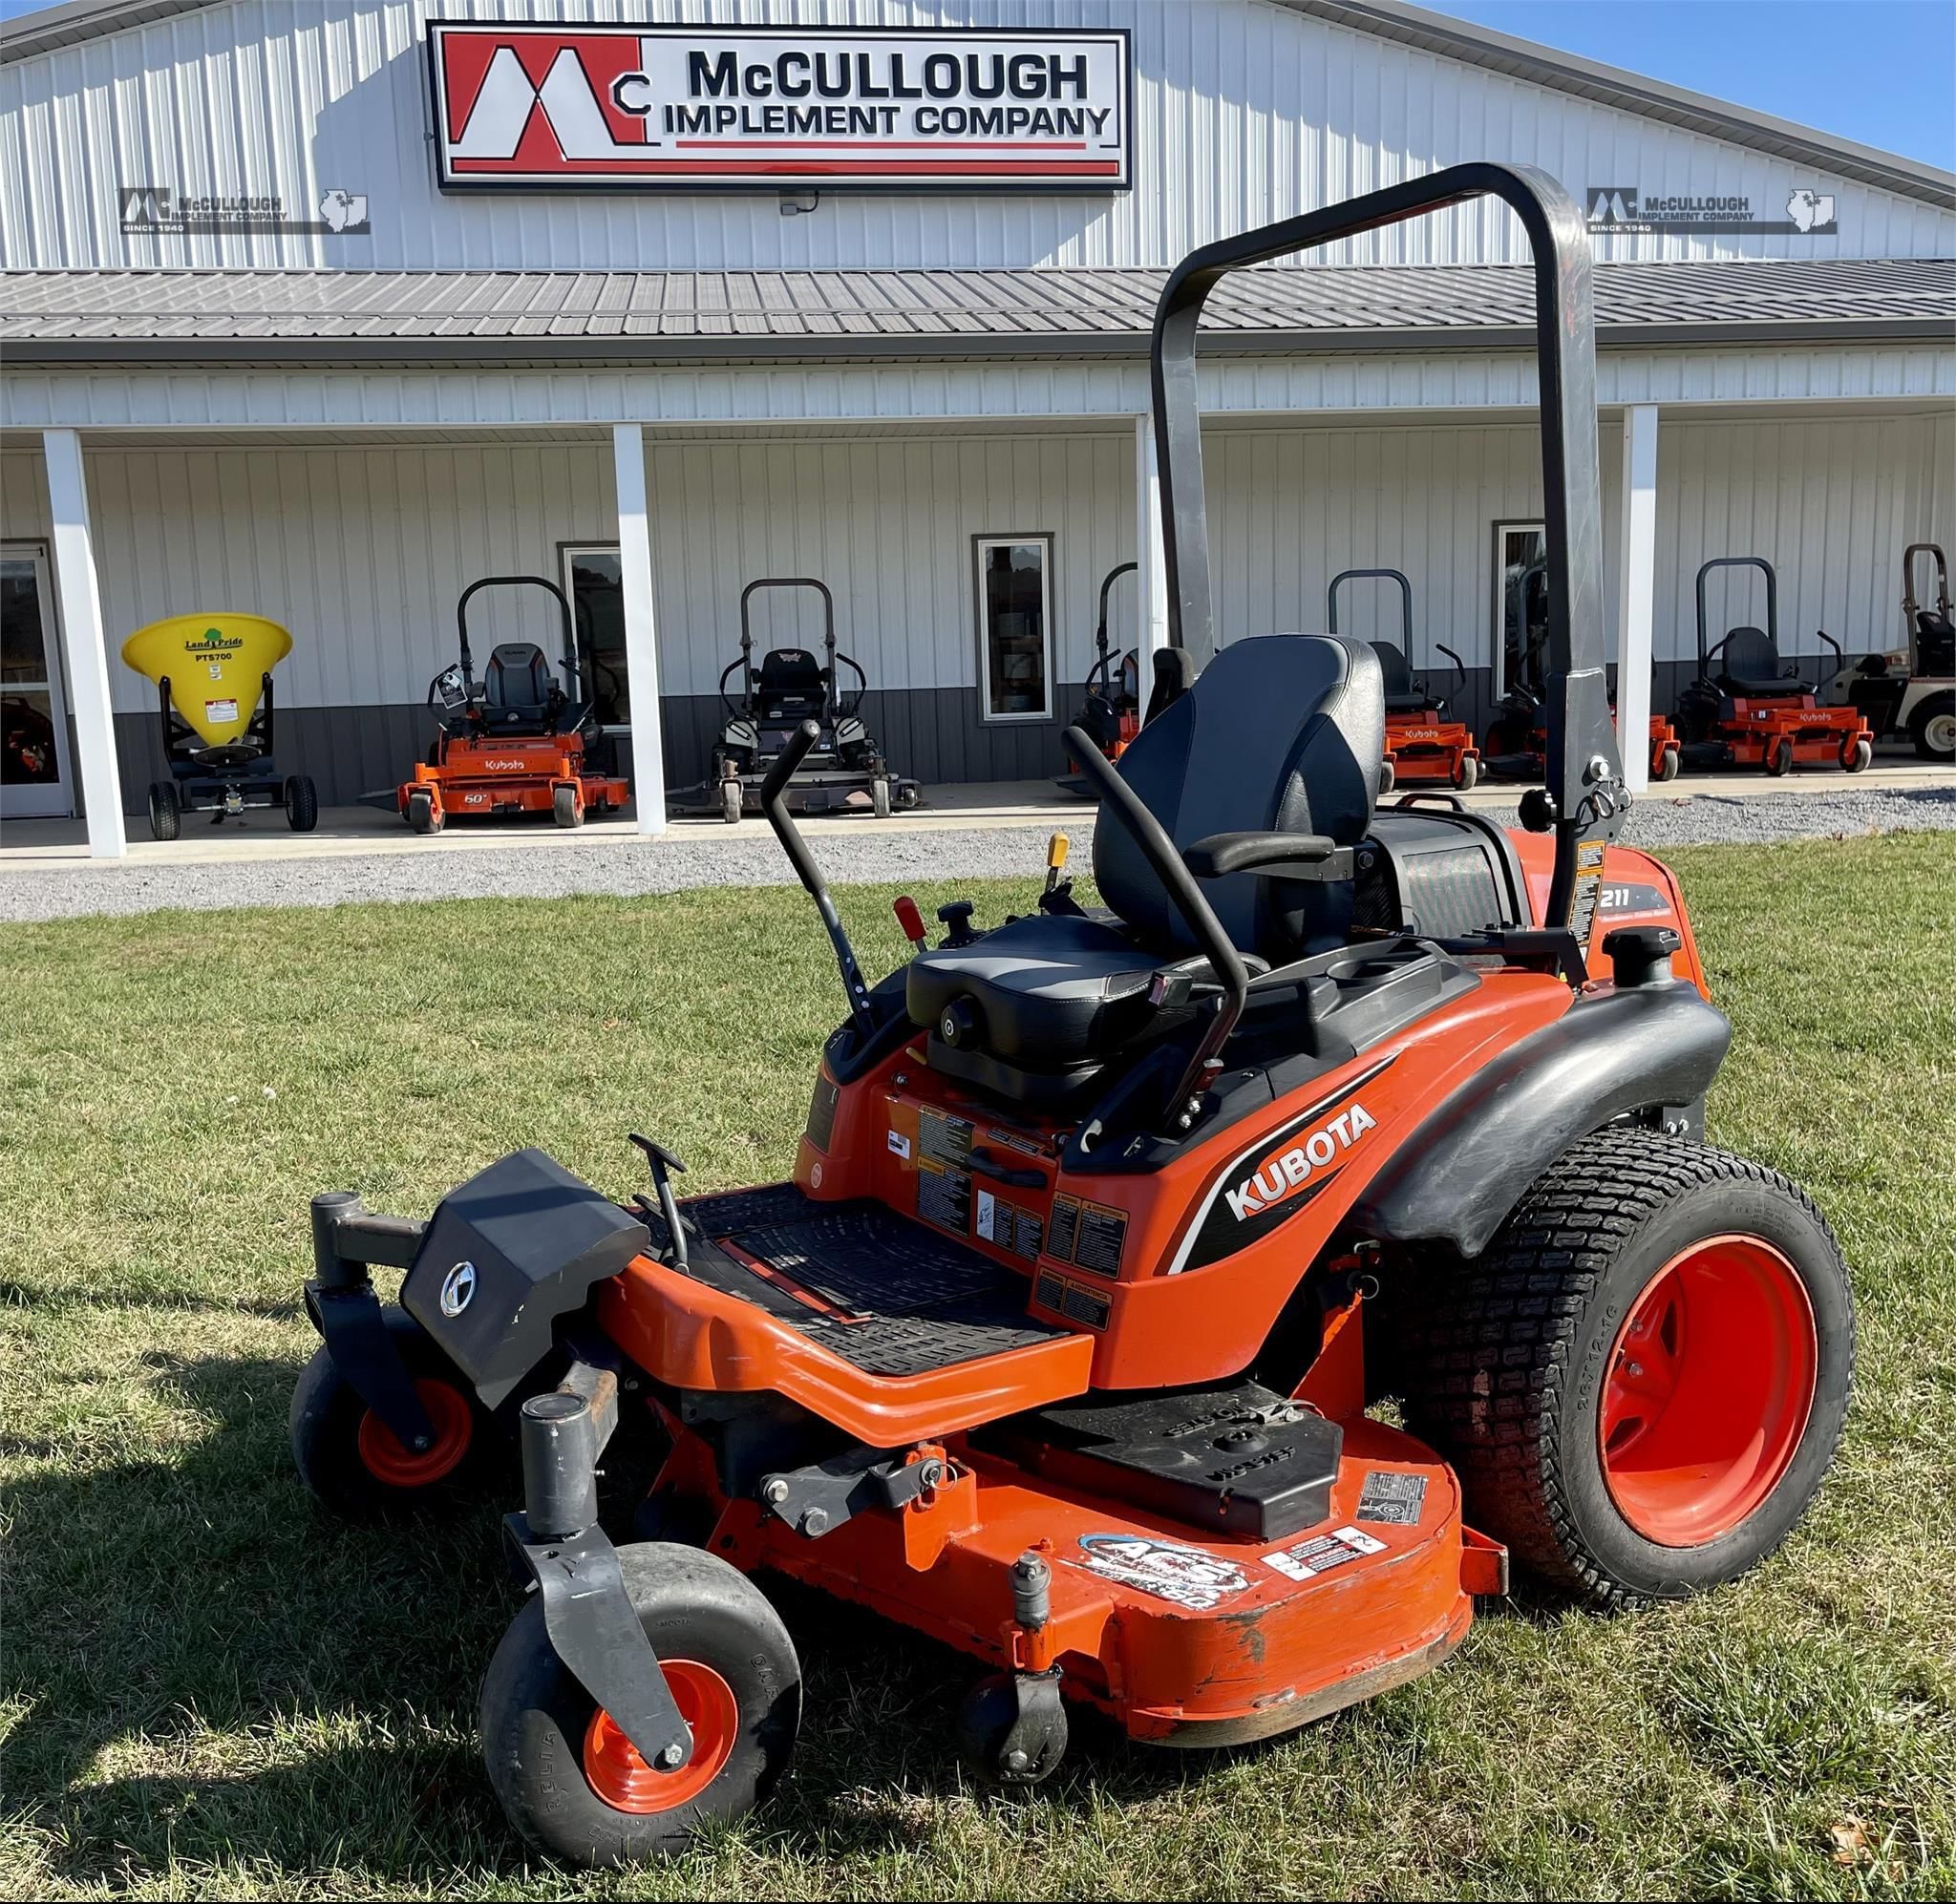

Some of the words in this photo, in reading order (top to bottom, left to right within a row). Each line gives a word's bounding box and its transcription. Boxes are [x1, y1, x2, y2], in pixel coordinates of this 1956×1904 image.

[689, 51, 1088, 99] McCULLOUGH
[666, 104, 901, 135] IMPLEMENT
[915, 106, 1112, 136] COMPANY
[185, 640, 210, 648] Land
[196, 653, 232, 662] PTS700
[1405, 729, 1438, 739] Kubota
[485, 759, 525, 770] Kubota
[1224, 1102, 1378, 1222] KUBOTA
